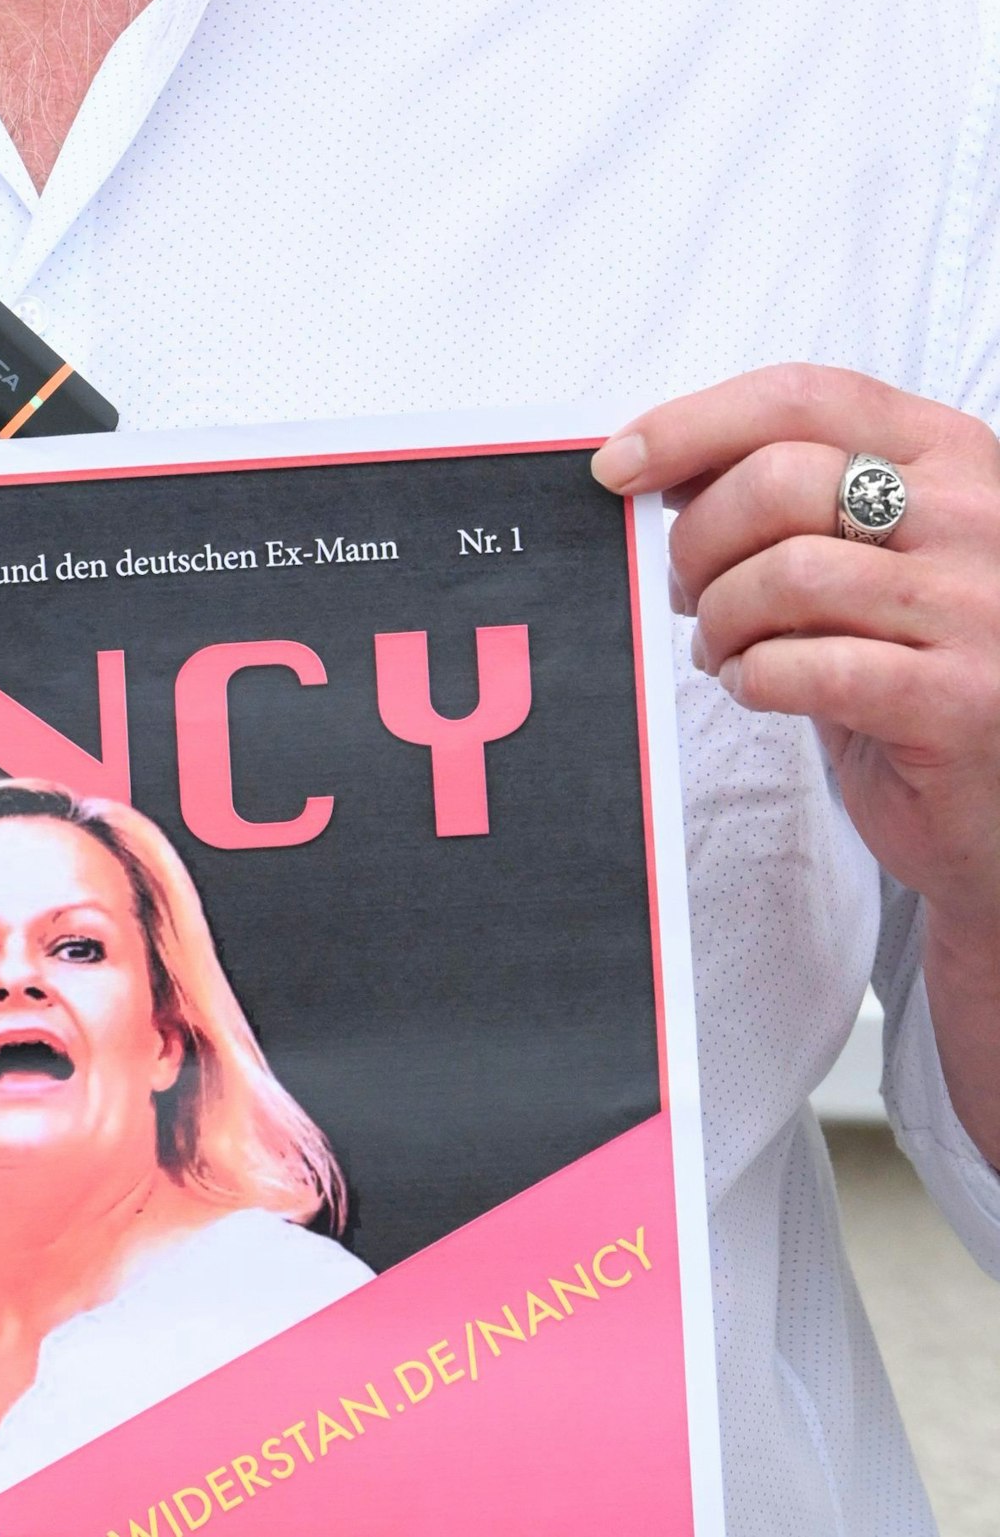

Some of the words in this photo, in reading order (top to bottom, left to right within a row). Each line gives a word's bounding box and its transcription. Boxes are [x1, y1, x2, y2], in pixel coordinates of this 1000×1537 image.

[55, 552, 109, 581] den
[115, 543, 259, 577] deutschen
[264, 536, 400, 567] Ex-Mann
[457, 527, 502, 555] Nr.
[510, 526, 524, 552] 1
